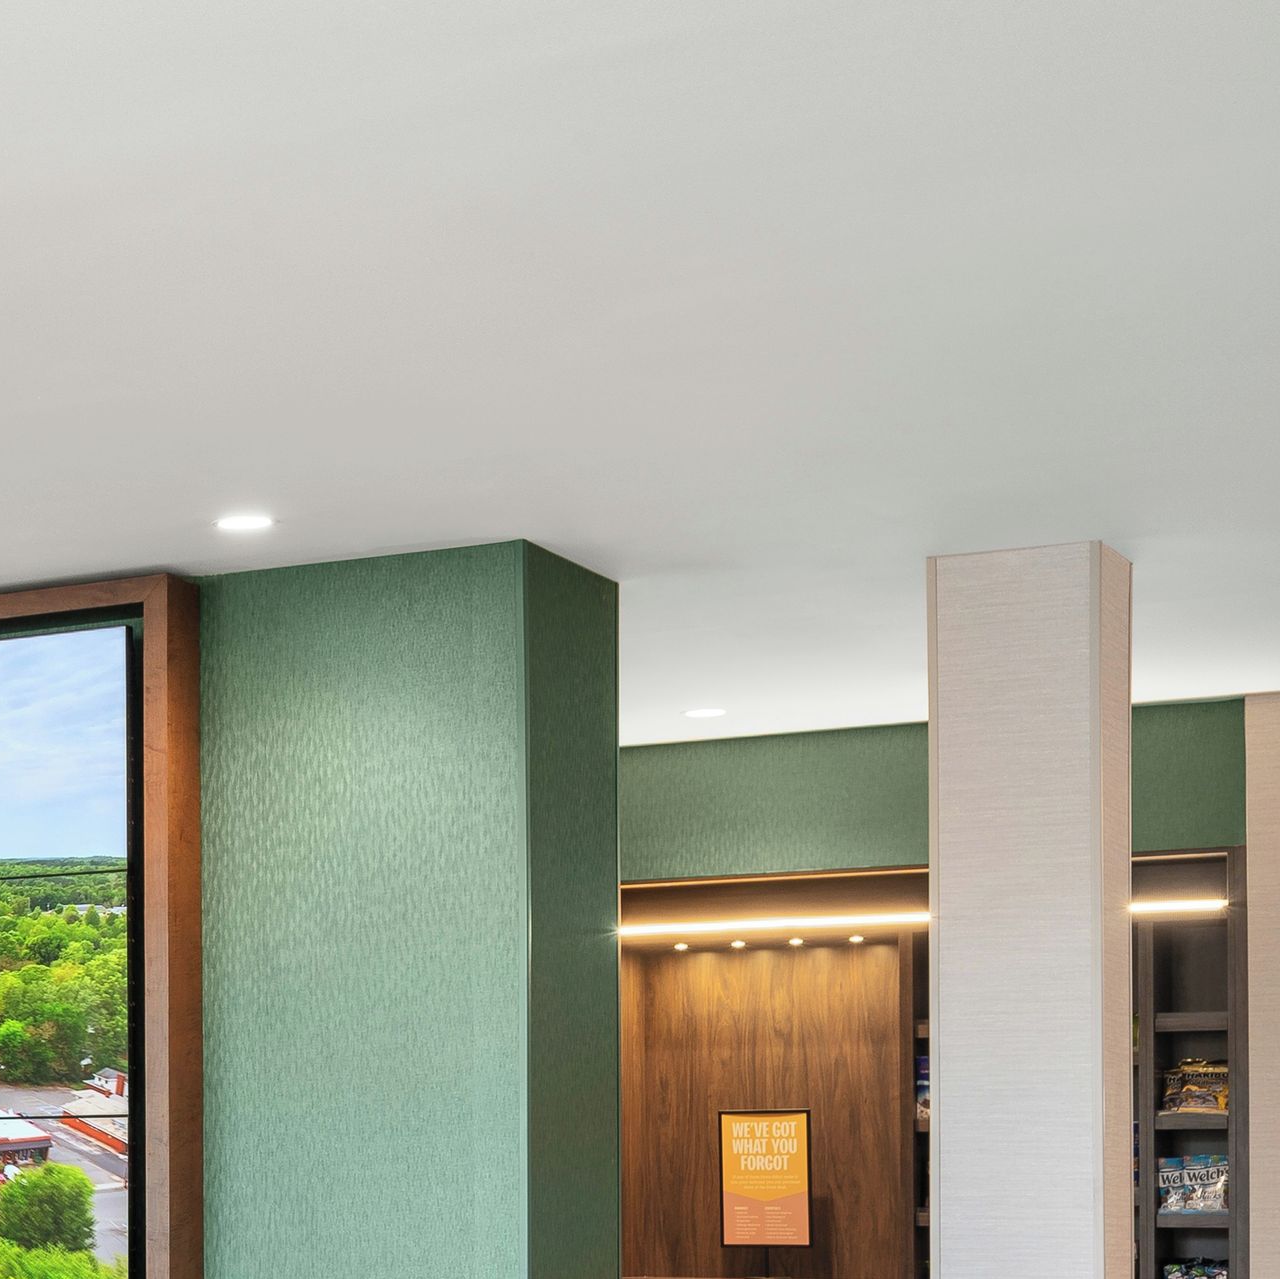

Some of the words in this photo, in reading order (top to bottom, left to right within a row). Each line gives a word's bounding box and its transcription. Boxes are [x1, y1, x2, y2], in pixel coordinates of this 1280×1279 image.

[732, 1122, 769, 1137] WE'VE
[772, 1121, 797, 1137] GOT
[732, 1139, 768, 1154] WHAT
[771, 1138, 797, 1153] YOU
[741, 1155, 789, 1170] FORGOT
